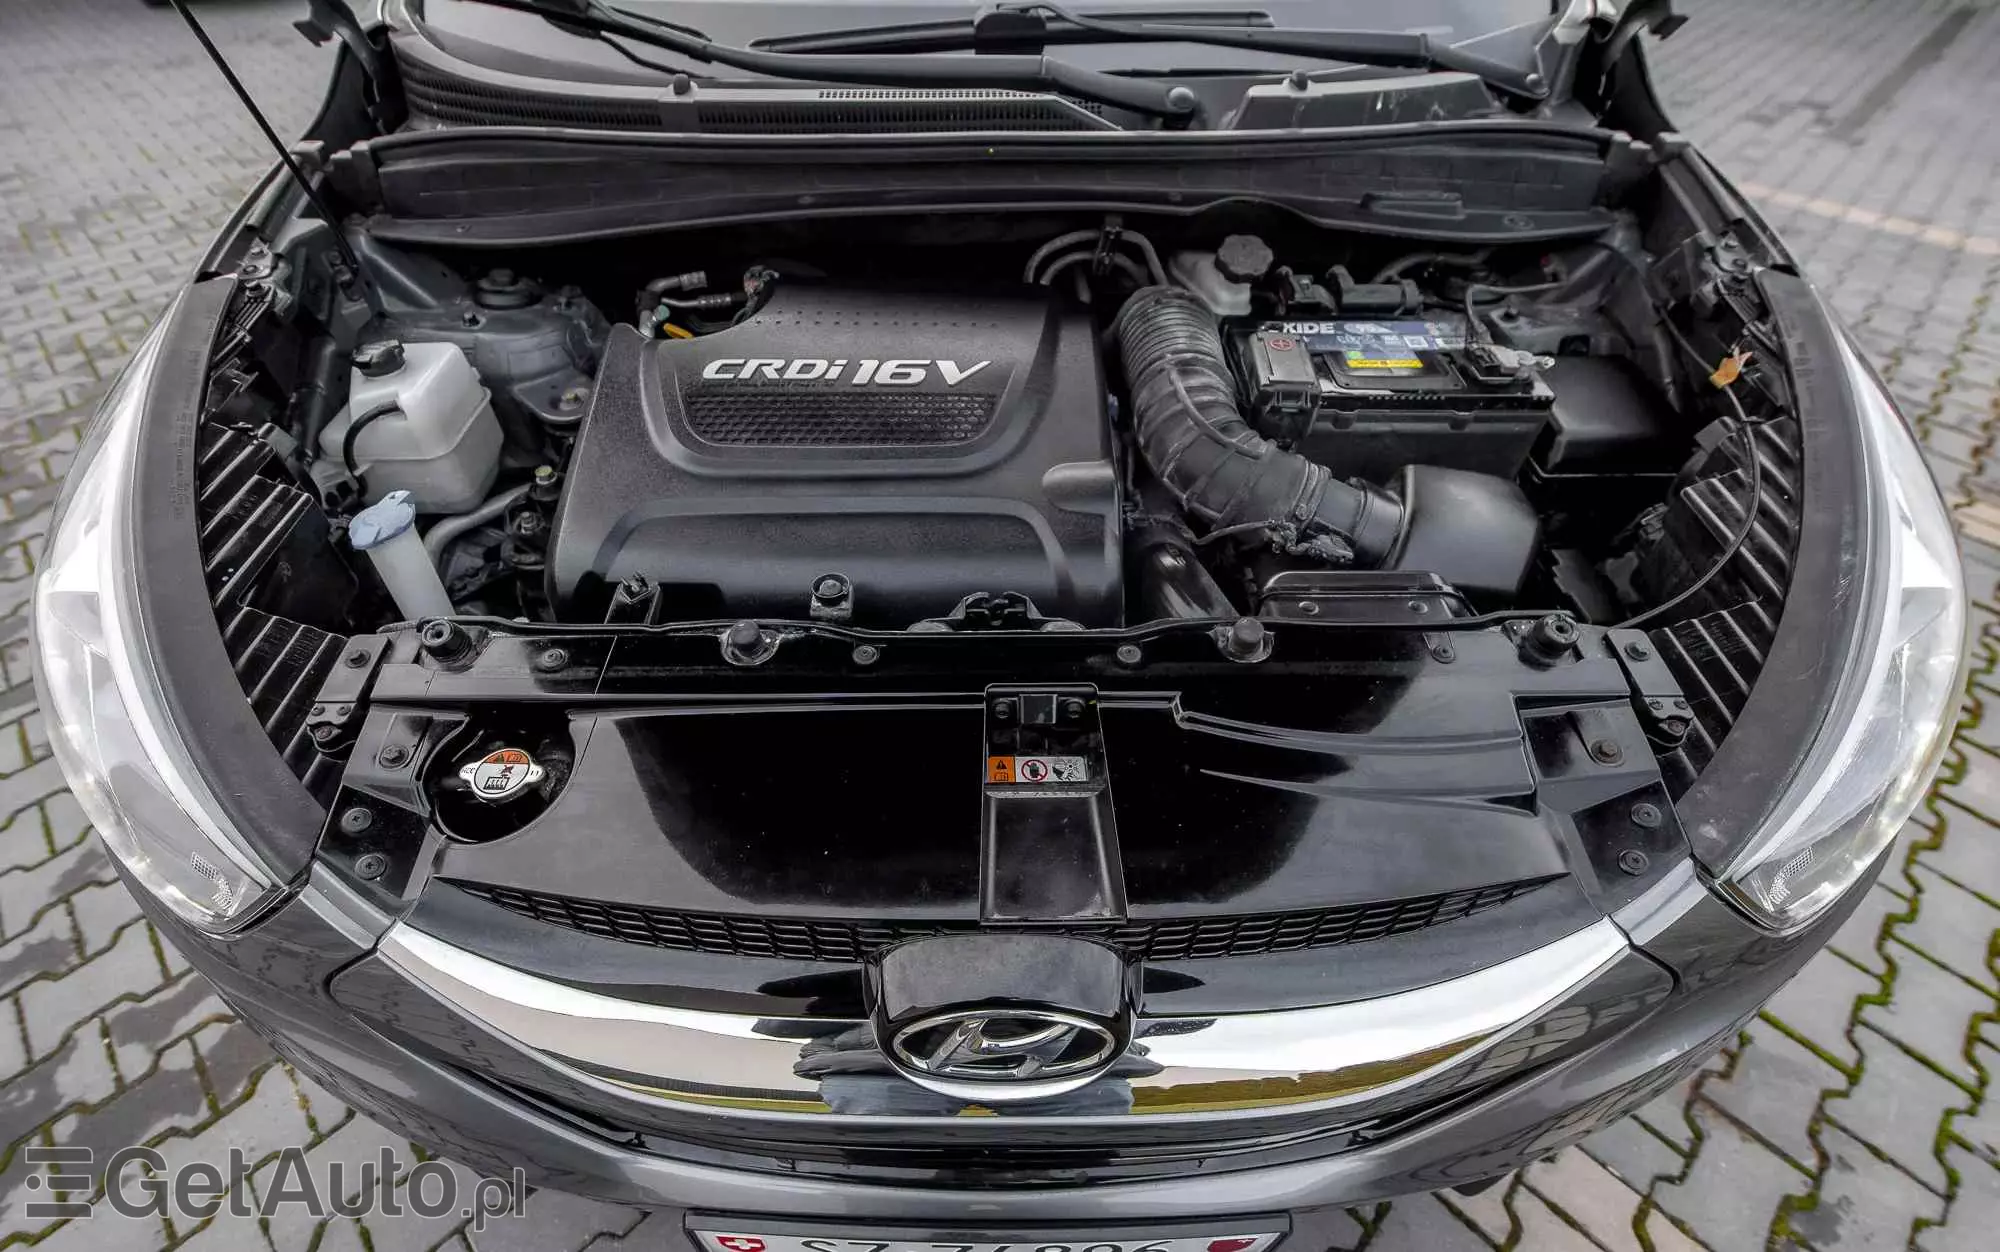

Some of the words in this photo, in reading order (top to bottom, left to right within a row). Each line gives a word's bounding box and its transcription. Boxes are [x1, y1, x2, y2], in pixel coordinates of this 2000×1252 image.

[1262, 322, 1335, 334] XIDE
[702, 358, 849, 380] CRDi
[852, 358, 993, 386] 16V
